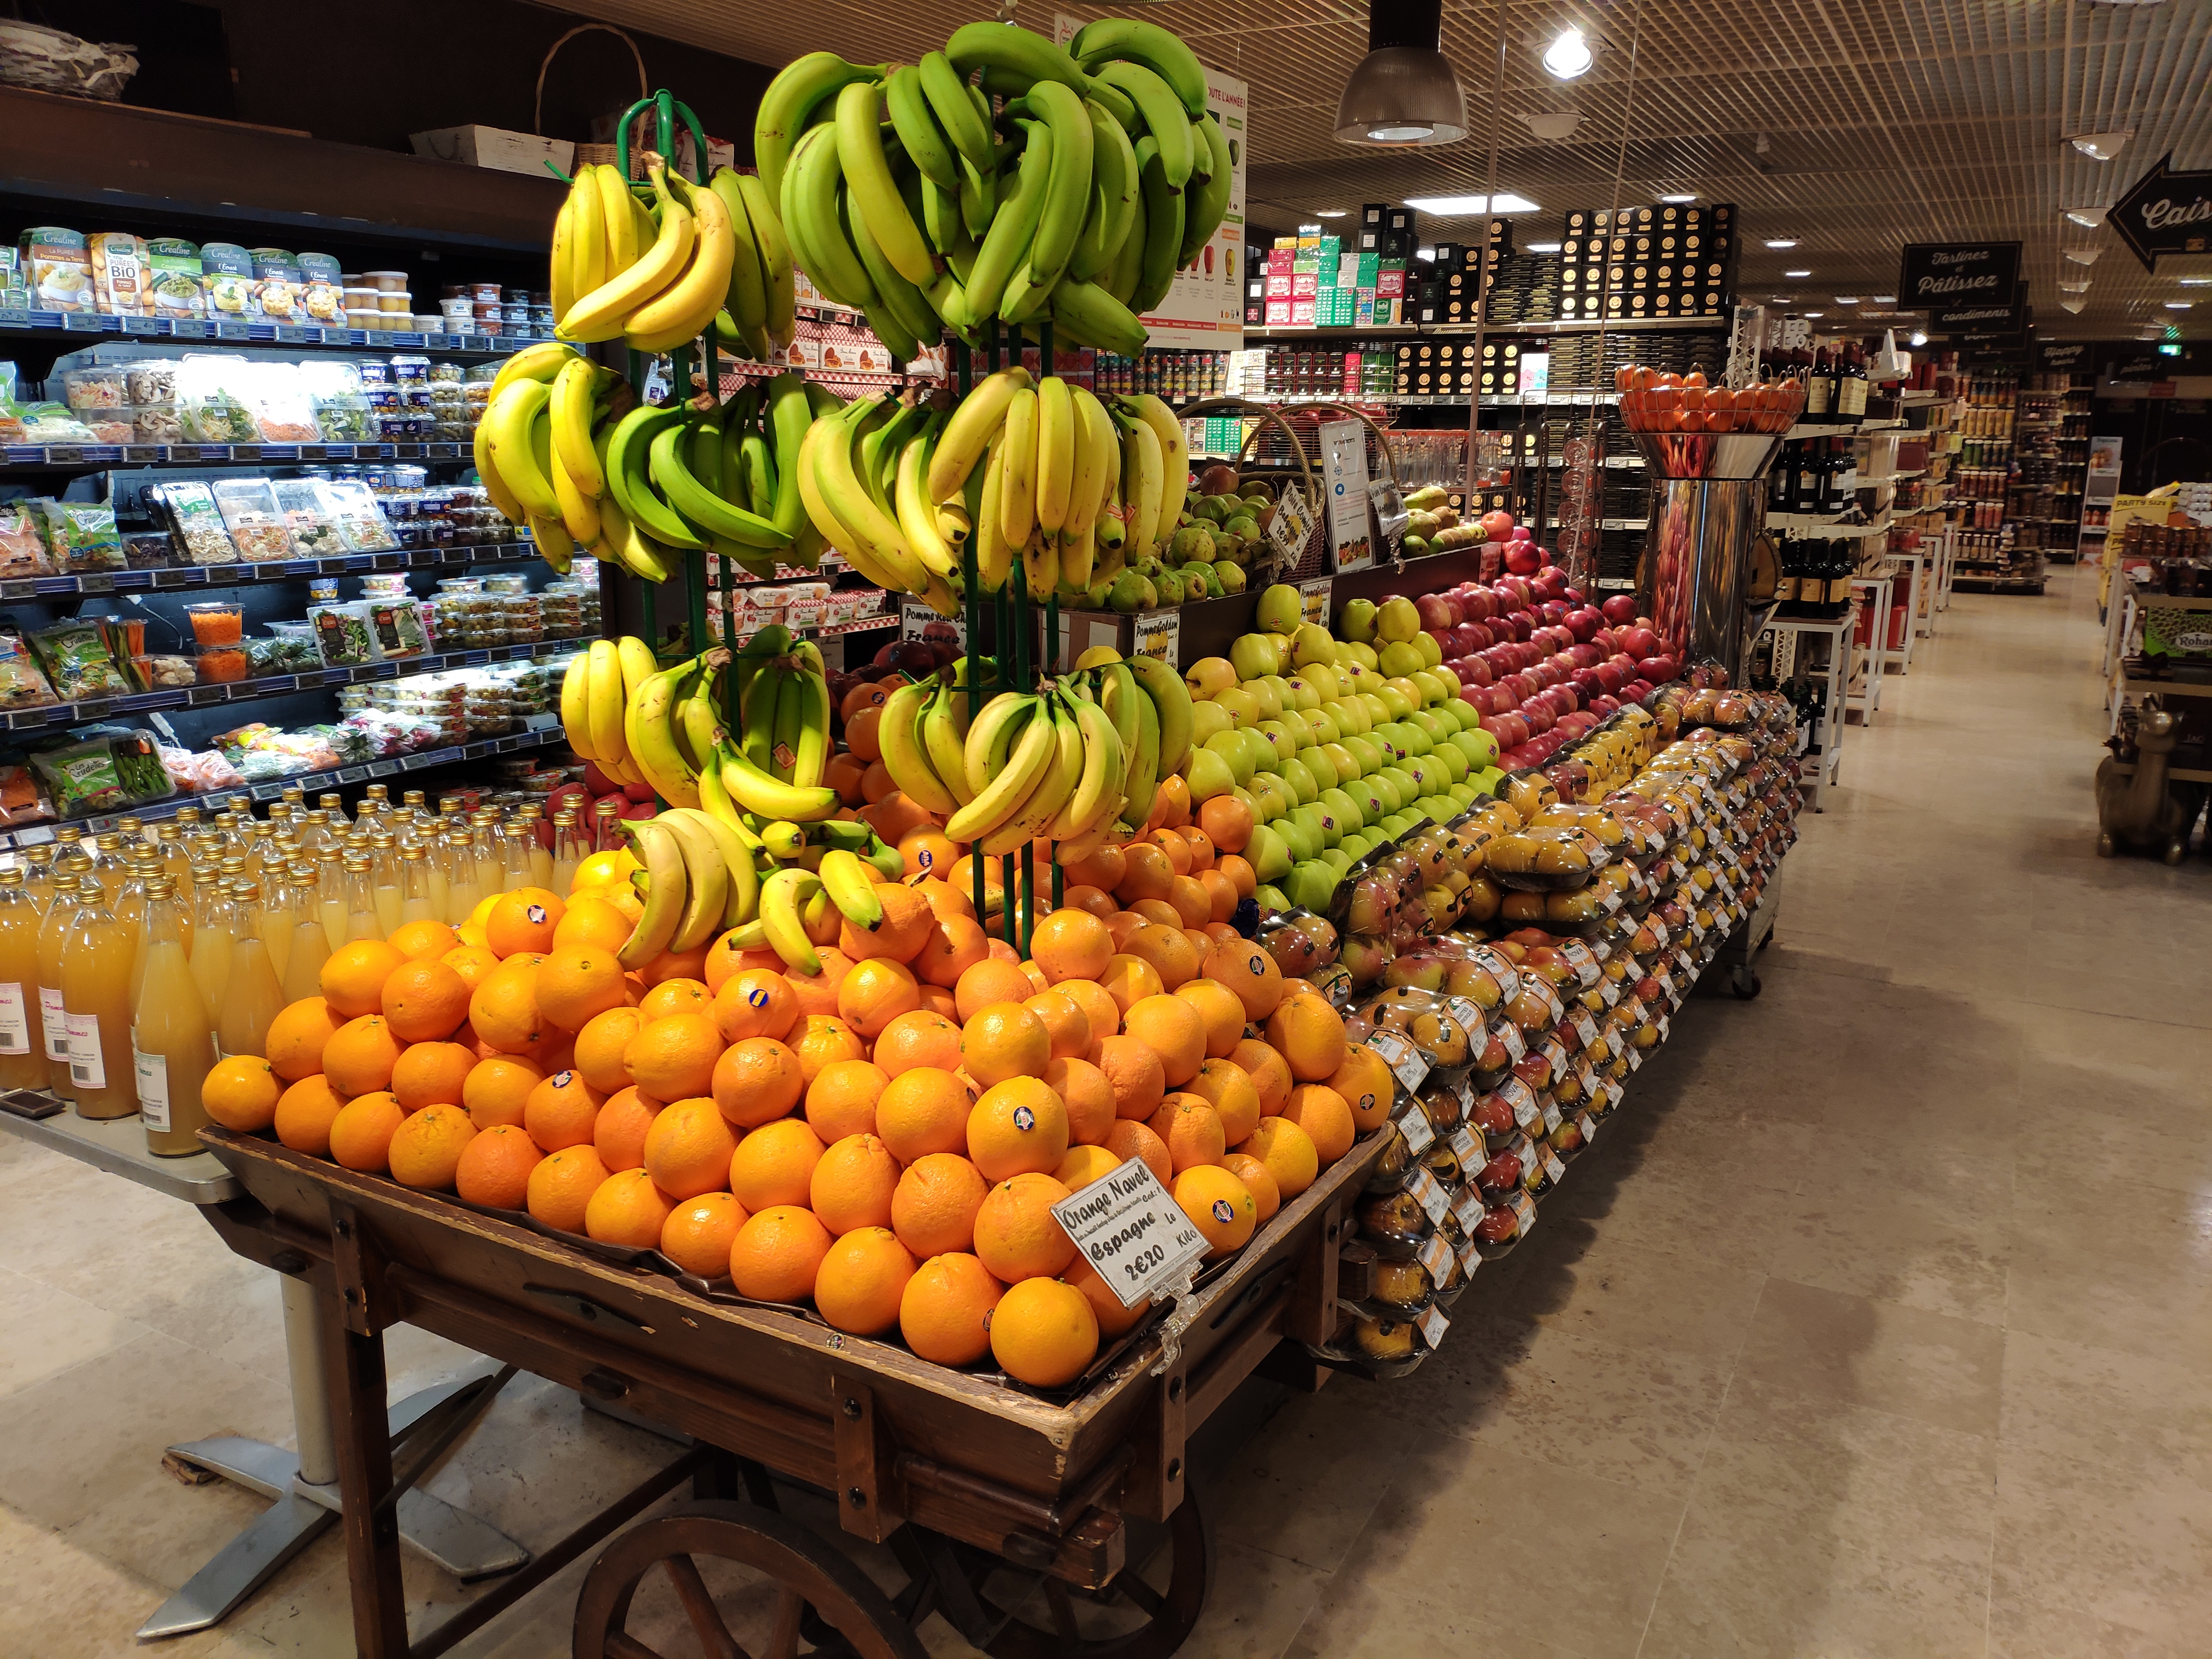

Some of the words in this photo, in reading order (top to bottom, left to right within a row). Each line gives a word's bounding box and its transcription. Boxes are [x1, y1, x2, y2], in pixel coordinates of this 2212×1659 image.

[1932, 250, 1989, 265] Tartinez
[1917, 275, 1998, 295] Pâtissez
[905, 607, 934, 623] Pomme
[906, 629, 961, 644] France
[1136, 625, 1156, 638] Pomme
[1158, 617, 1177, 636] Golden
[1062, 1193, 1111, 1229] Orange
[1108, 1164, 1149, 1201] Navel
[1164, 1212, 1176, 1224] Le
[1091, 1211, 1156, 1261] Espagne
[1125, 1244, 1165, 1281] 2€20
